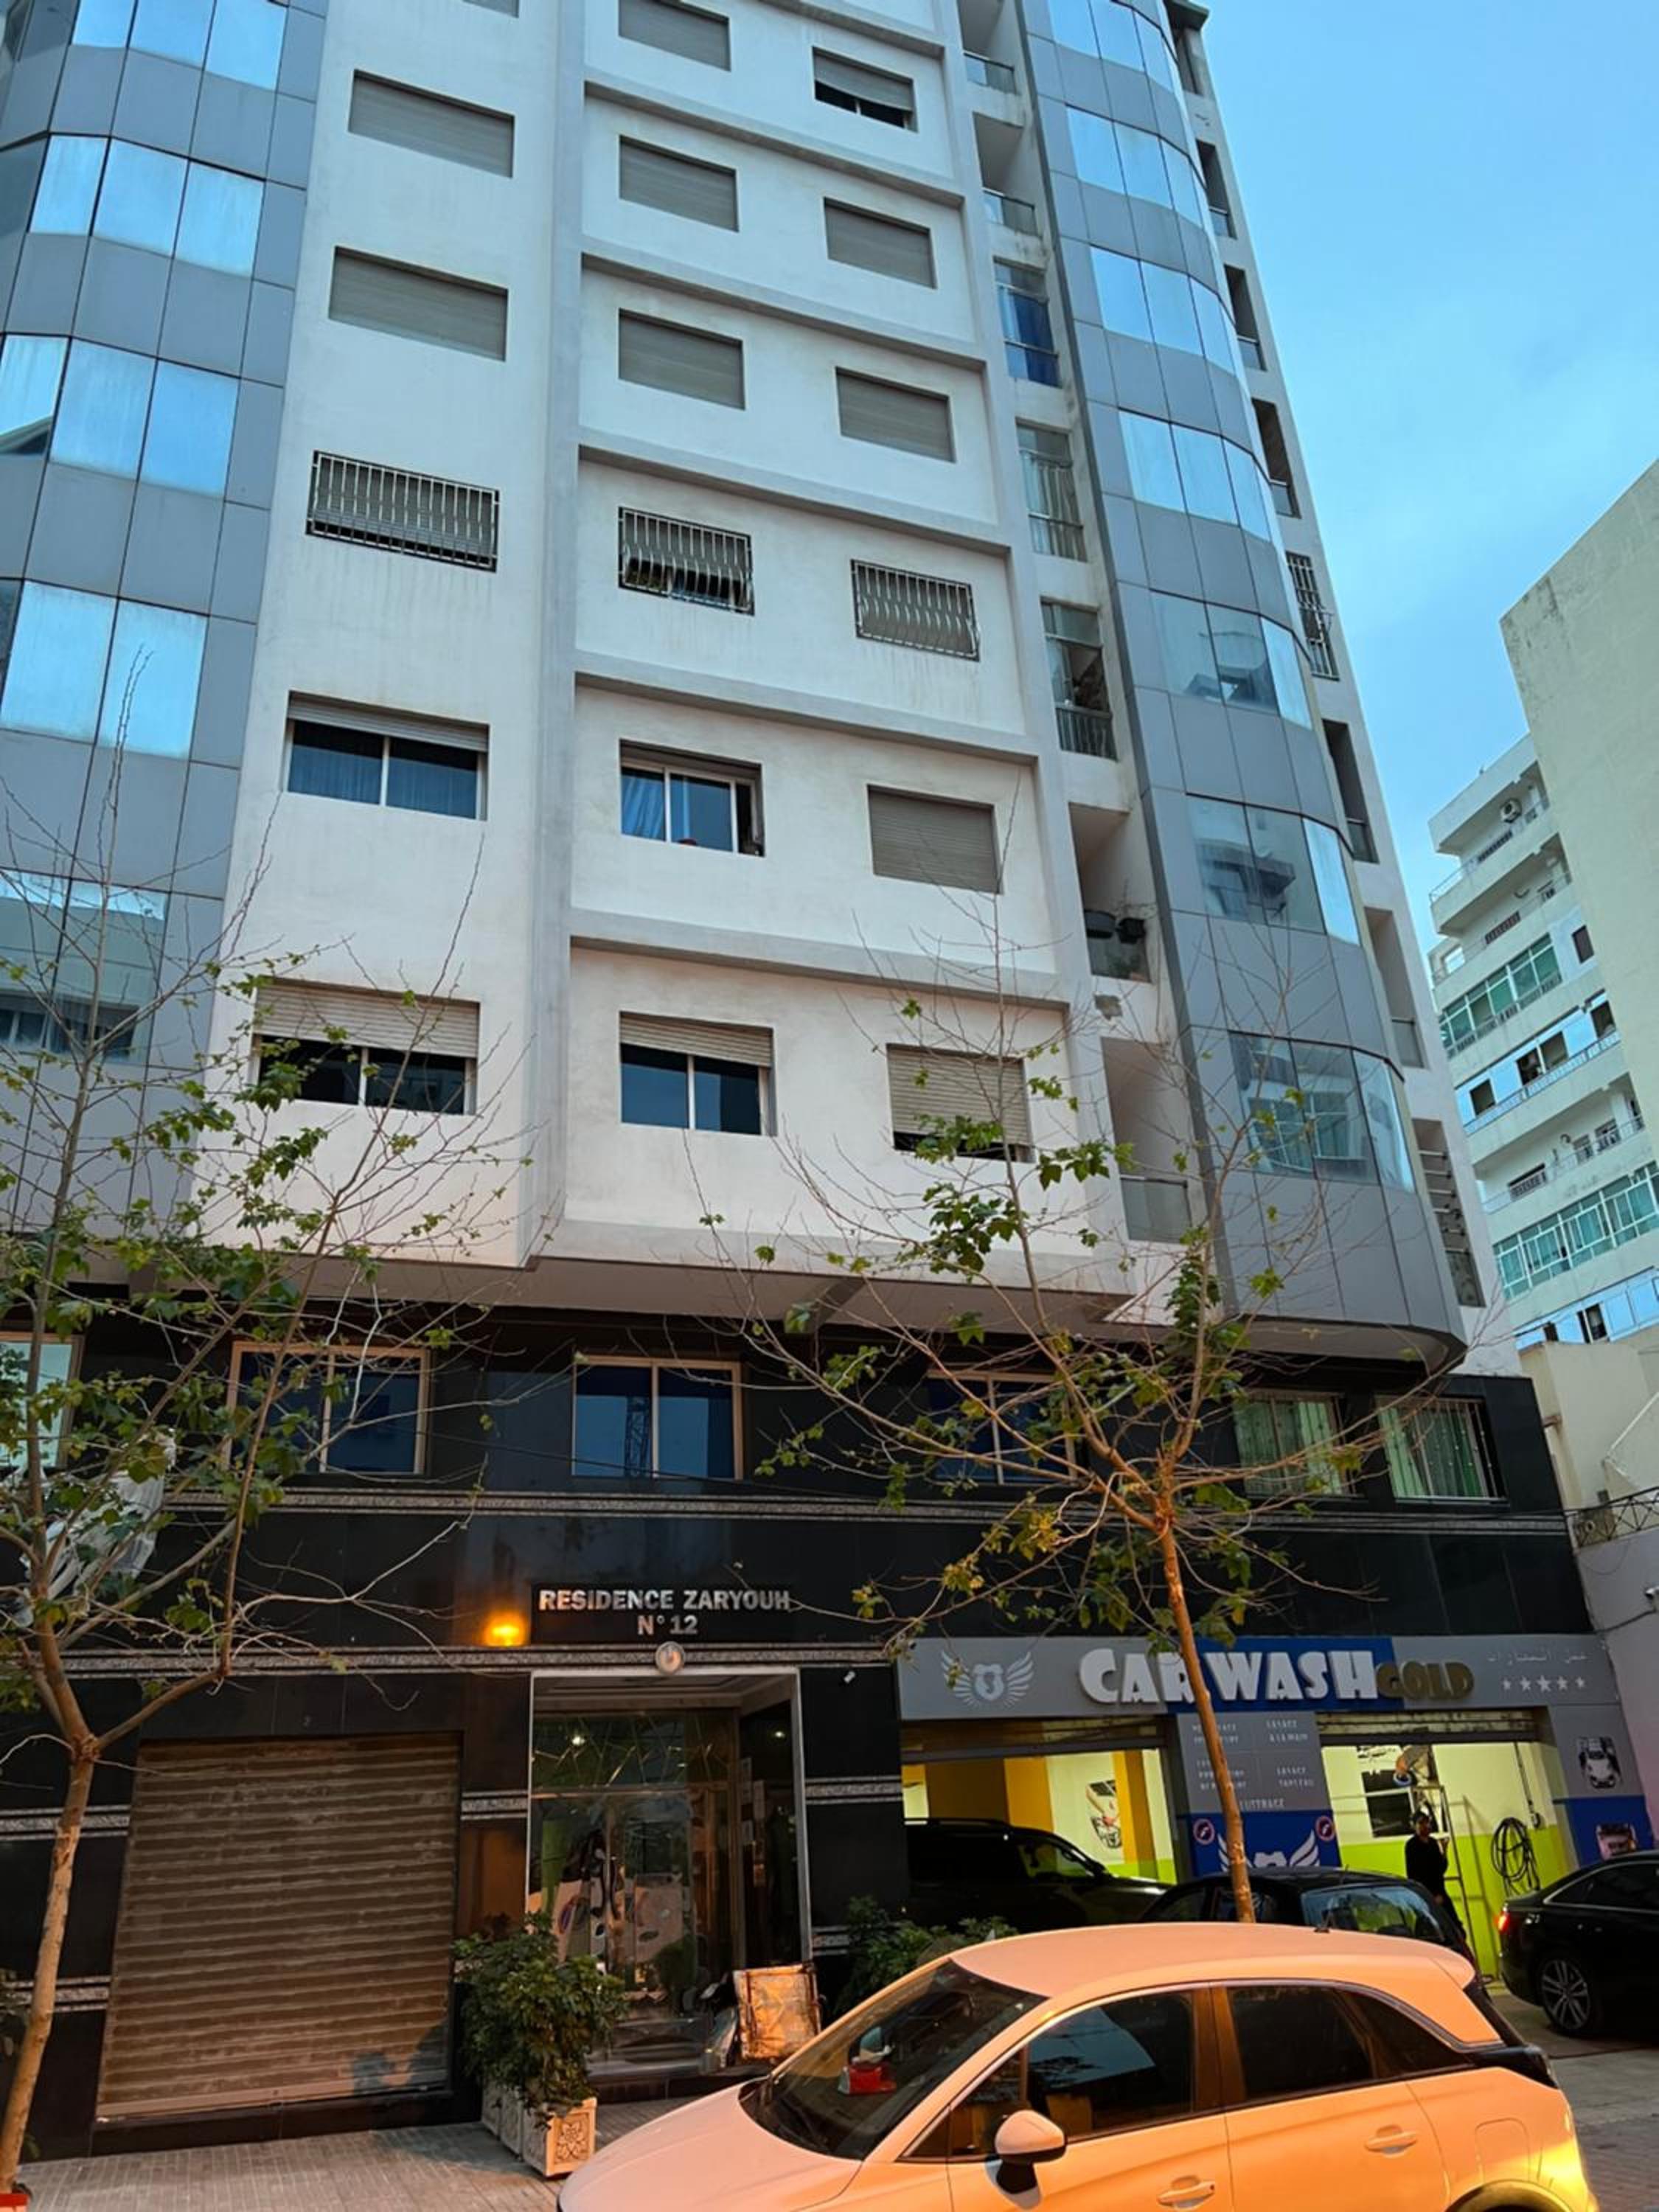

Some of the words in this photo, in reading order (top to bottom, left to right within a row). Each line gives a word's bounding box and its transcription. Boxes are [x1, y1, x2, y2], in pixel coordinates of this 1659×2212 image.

[538, 1590, 674, 1610] RESIDENCE
[684, 1590, 790, 1611] ZARYOUH
[1080, 1649, 1196, 1703] CAR
[1203, 1649, 1378, 1701] WASH
[1377, 1660, 1474, 1701] GOLD
